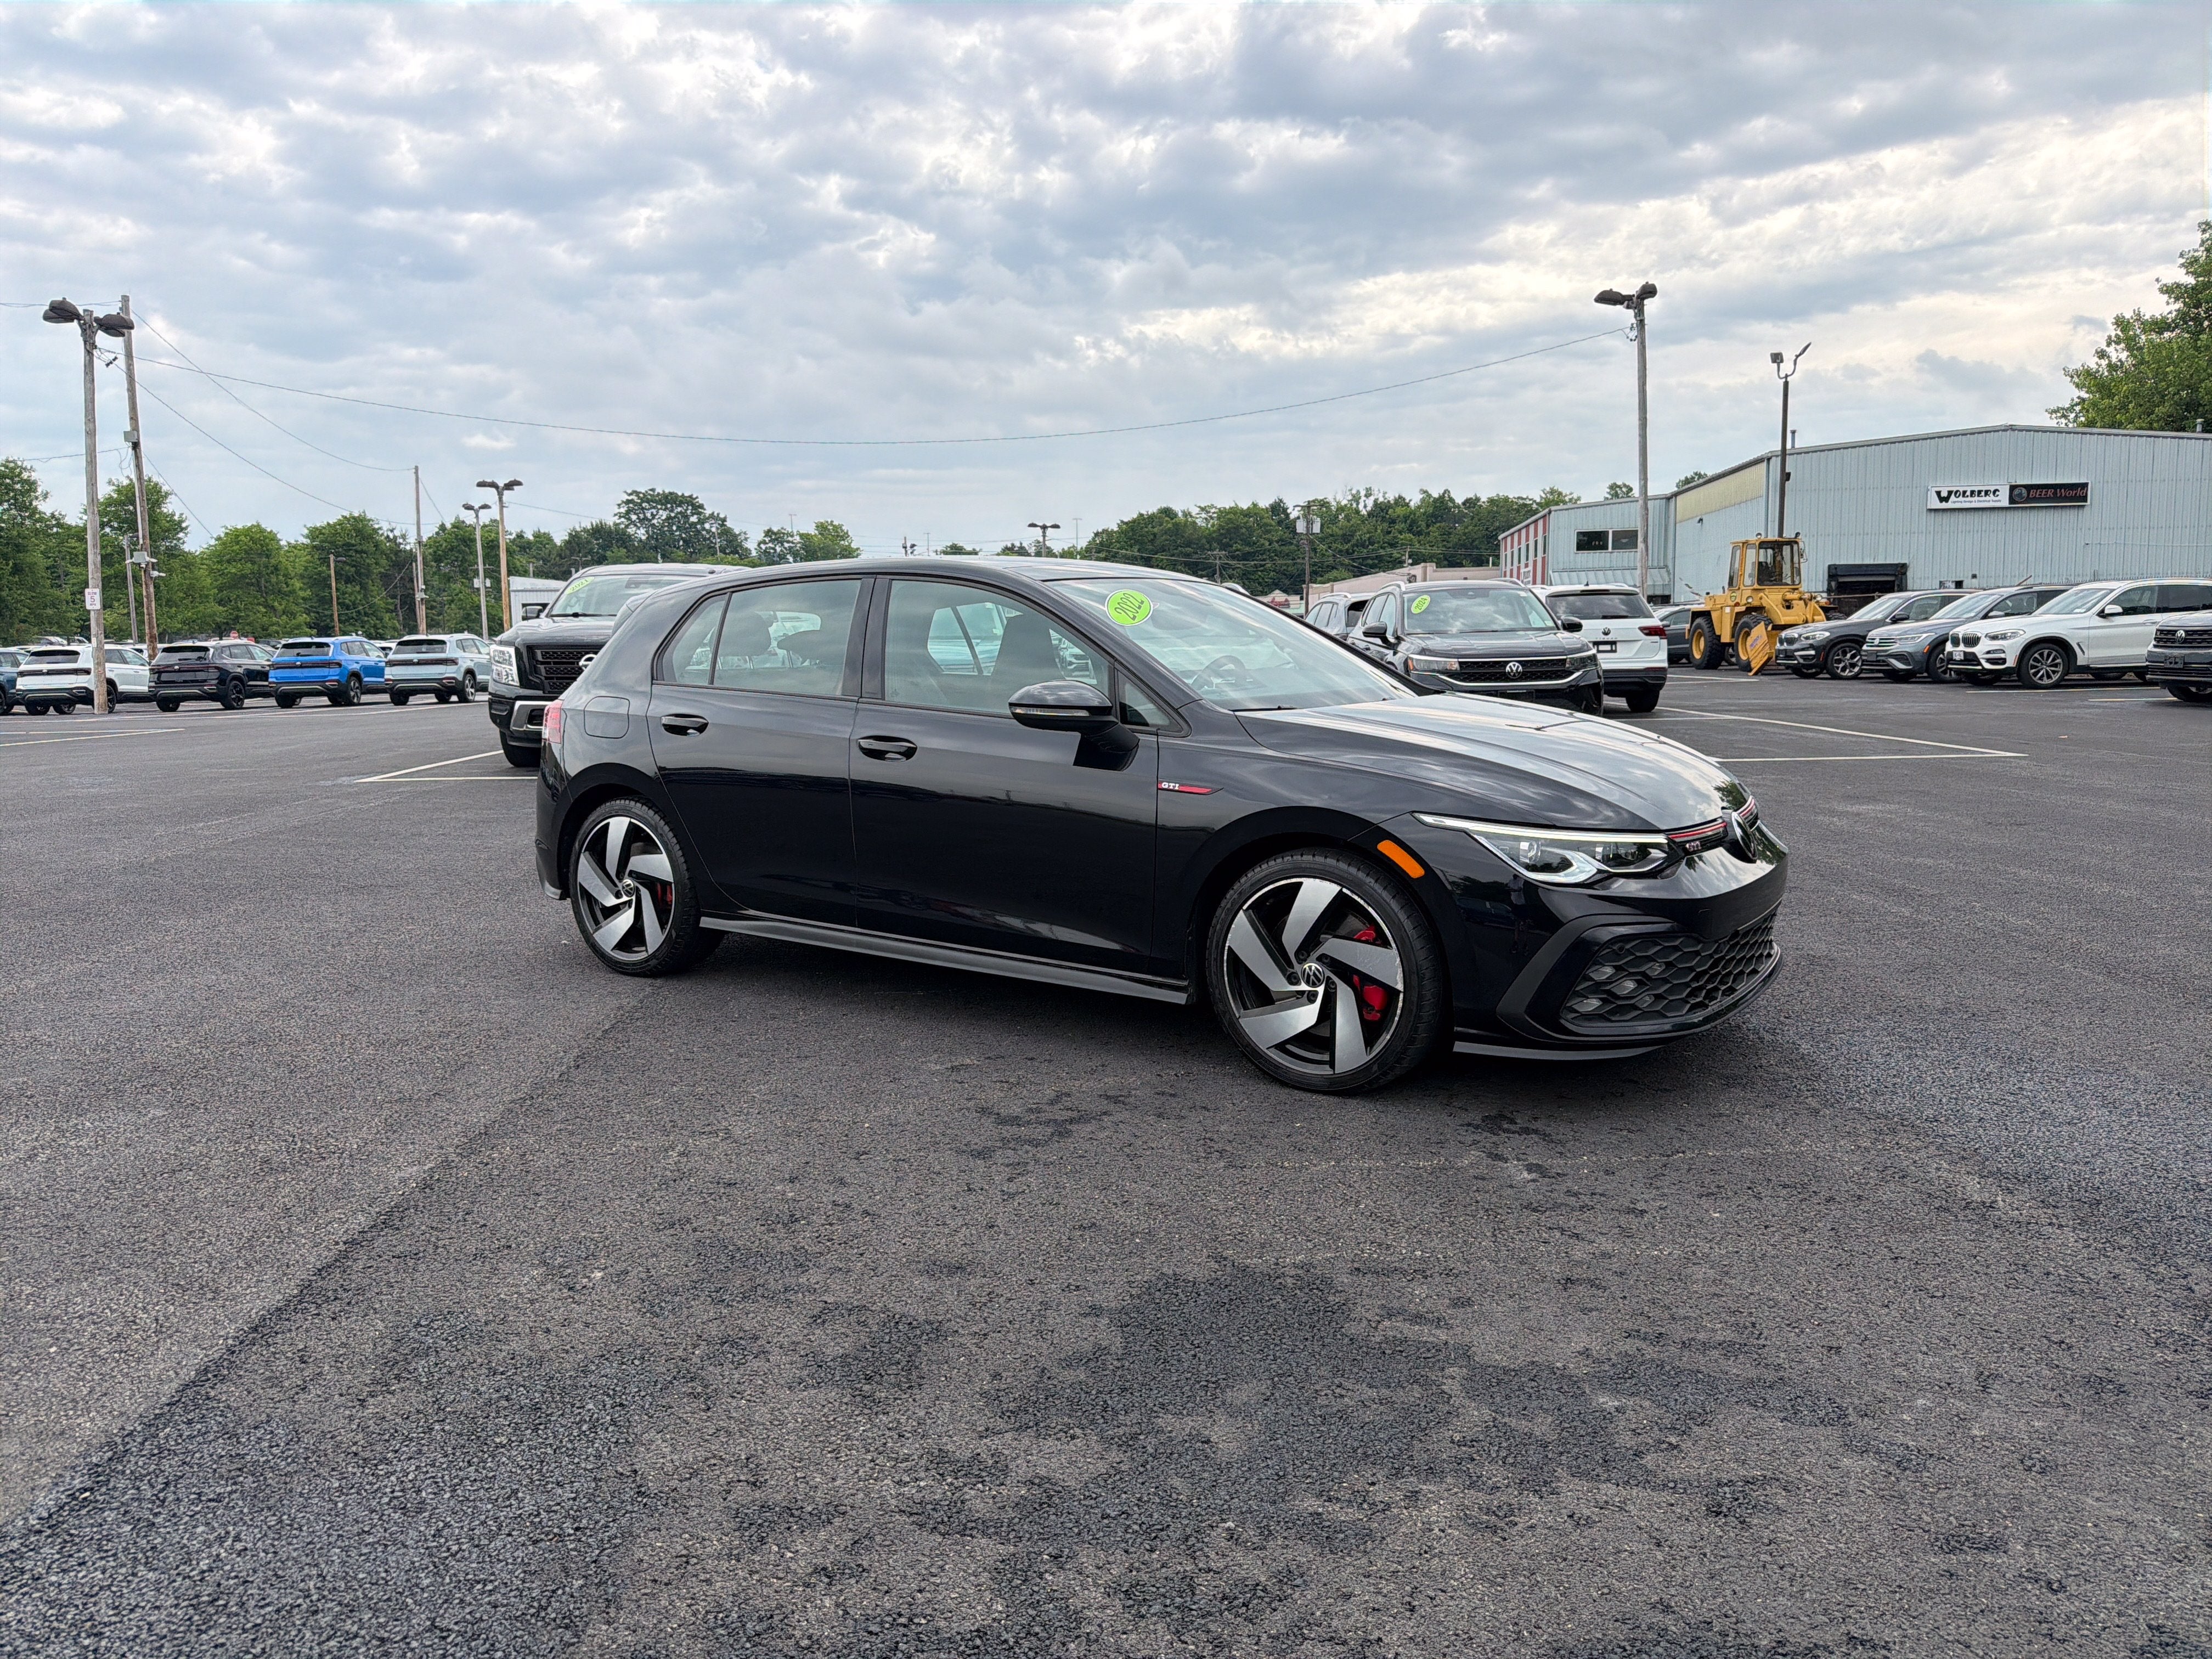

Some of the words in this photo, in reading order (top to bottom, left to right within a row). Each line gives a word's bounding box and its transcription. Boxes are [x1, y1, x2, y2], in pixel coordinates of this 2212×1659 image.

[2029, 489, 2055, 498] BEER
[2056, 487, 2087, 498] World
[569, 579, 589, 591] 2021
[1114, 592, 1145, 621] 2022
[1414, 597, 1428, 611] 2024
[1161, 782, 1180, 790] GTI
